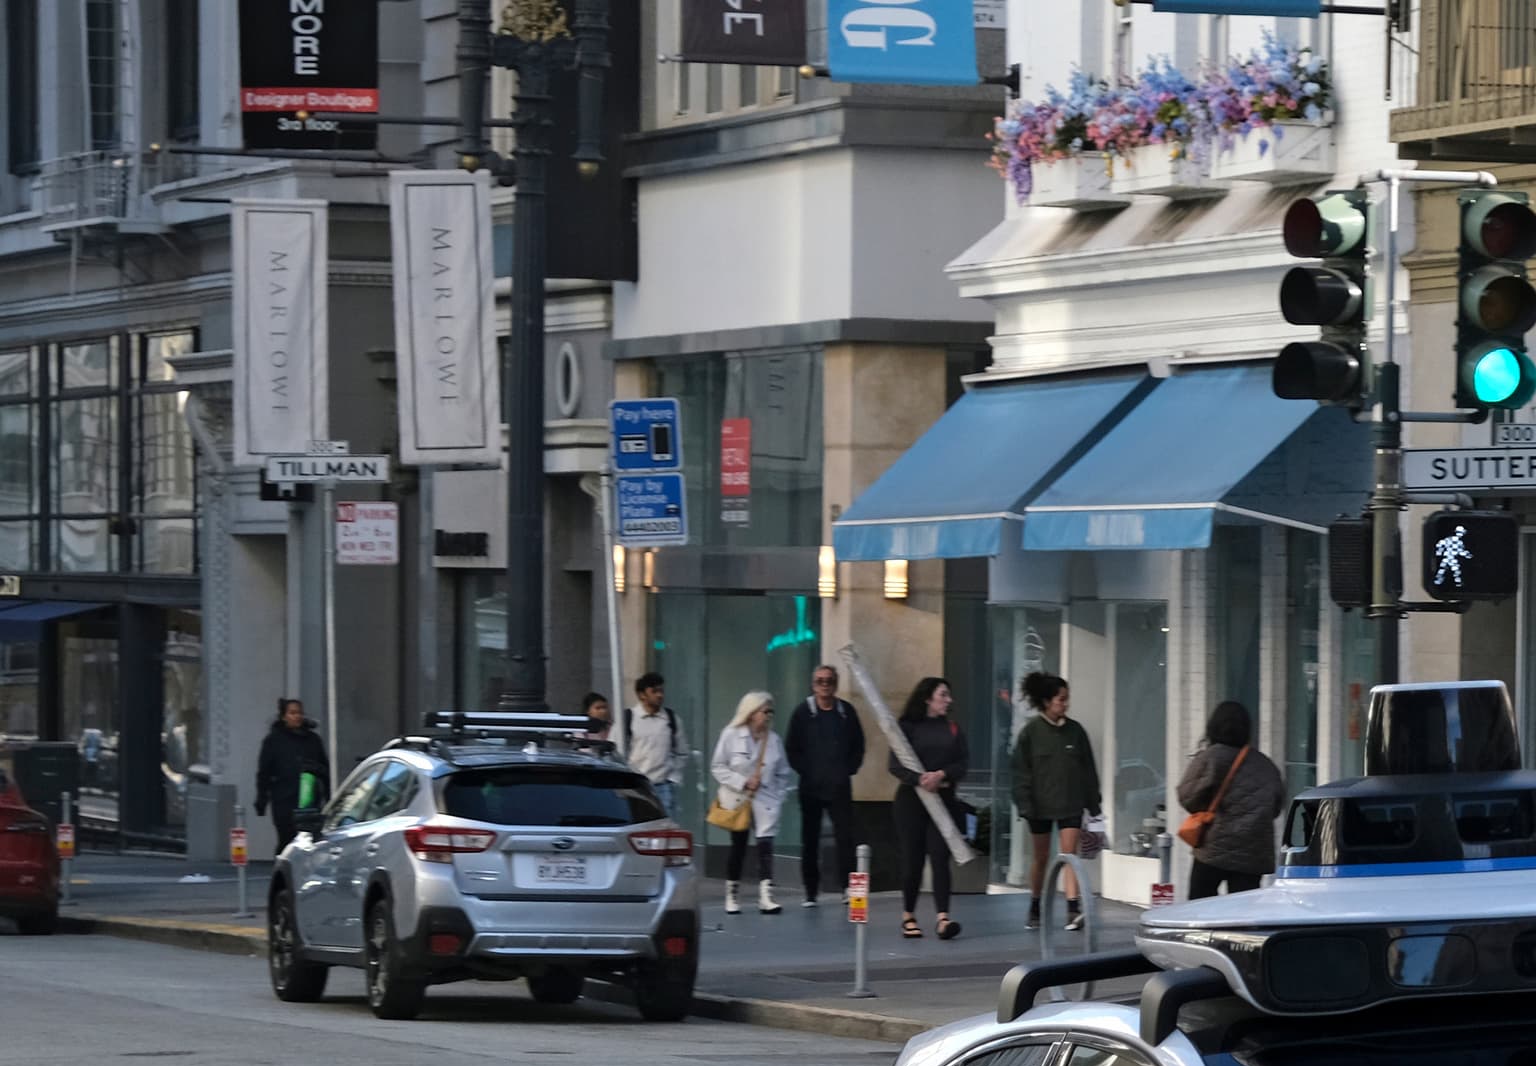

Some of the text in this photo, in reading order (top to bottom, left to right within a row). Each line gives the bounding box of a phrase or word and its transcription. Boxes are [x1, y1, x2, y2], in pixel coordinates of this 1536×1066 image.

[246, 92, 374, 109] Designer Boutique
[615, 407, 674, 423] Pay here
[1501, 426, 1534, 441] 300
[277, 461, 378, 477] TILLMAN
[620, 480, 664, 494] Pay by
[620, 493, 669, 505] License
[622, 506, 655, 518] Plate
